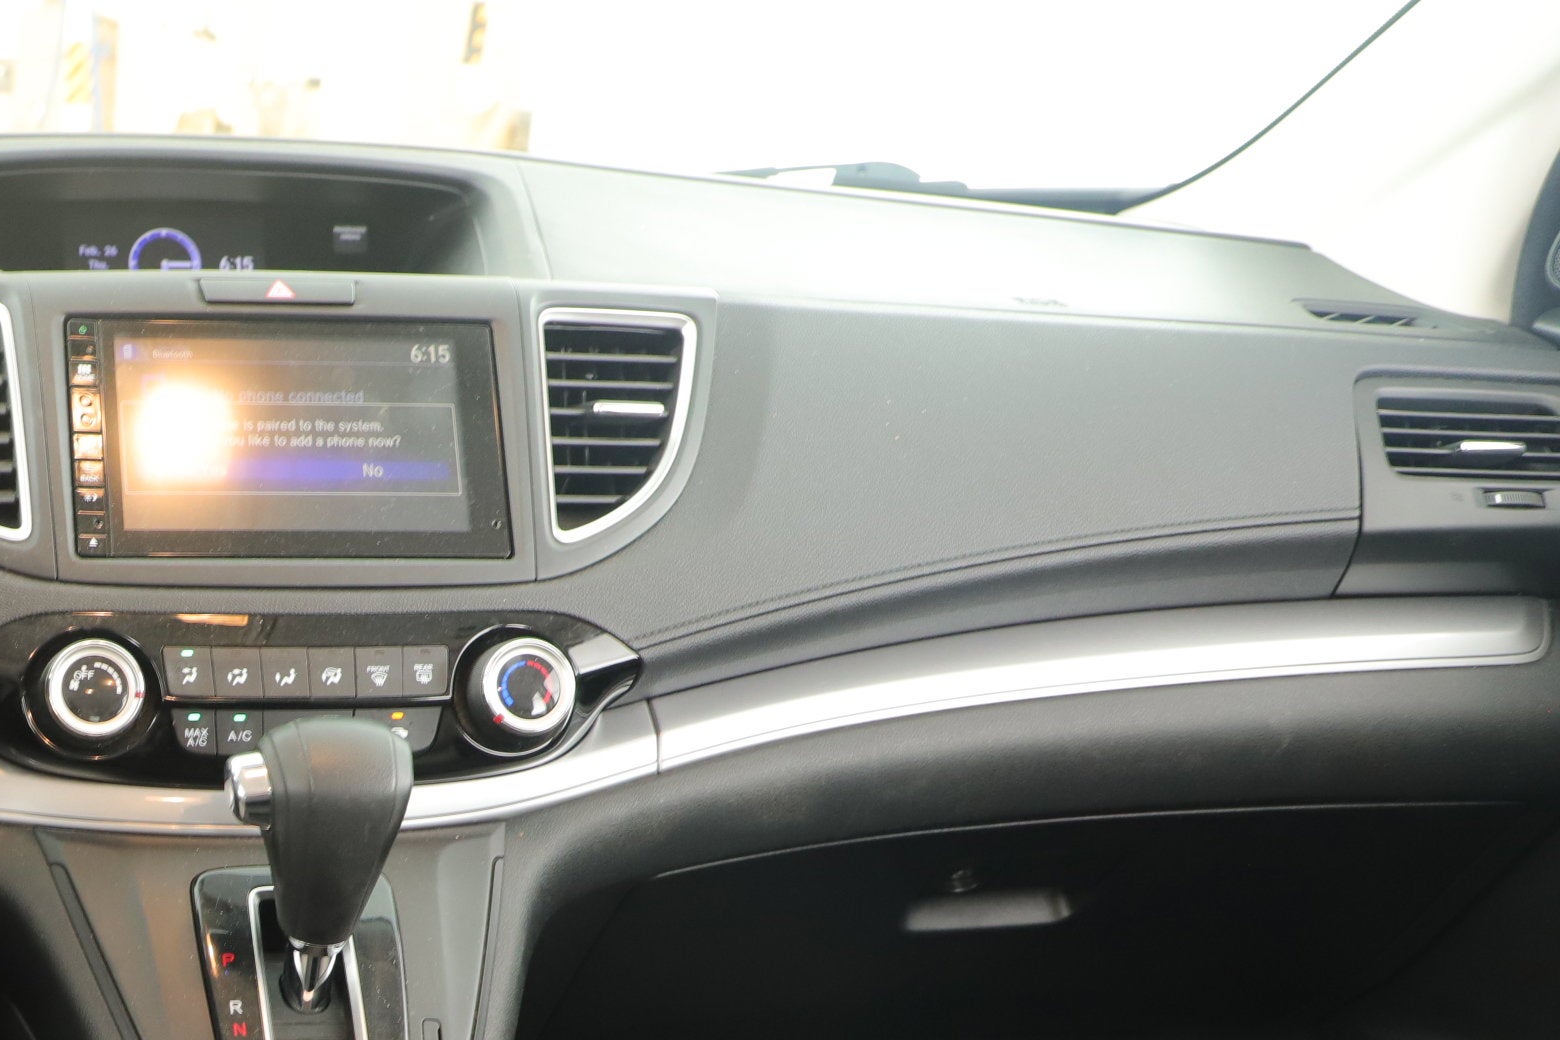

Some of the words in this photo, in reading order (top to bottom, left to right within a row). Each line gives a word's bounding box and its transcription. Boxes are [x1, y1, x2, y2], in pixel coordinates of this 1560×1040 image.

[219, 255, 254, 270] 6:15
[410, 344, 451, 363] 6:15
[239, 390, 284, 404] phone
[288, 389, 364, 404] connected
[243, 419, 254, 432] is
[256, 418, 296, 433] paired
[299, 419, 312, 432] to
[315, 418, 335, 432] the
[338, 419, 384, 433] system.
[248, 433, 271, 447] like
[274, 434, 286, 447] to
[290, 433, 313, 447] add
[315, 437, 323, 447] a
[326, 434, 365, 449] phone
[368, 435, 402, 448] now?
[363, 463, 384, 478] No
[73, 669, 95, 681] OFF
[184, 727, 209, 738] MAX
[227, 730, 253, 742] A/C
[187, 736, 208, 747] A/C
[221, 953, 235, 967] P
[229, 1000, 243, 1015] R
[233, 1022, 247, 1036] N
